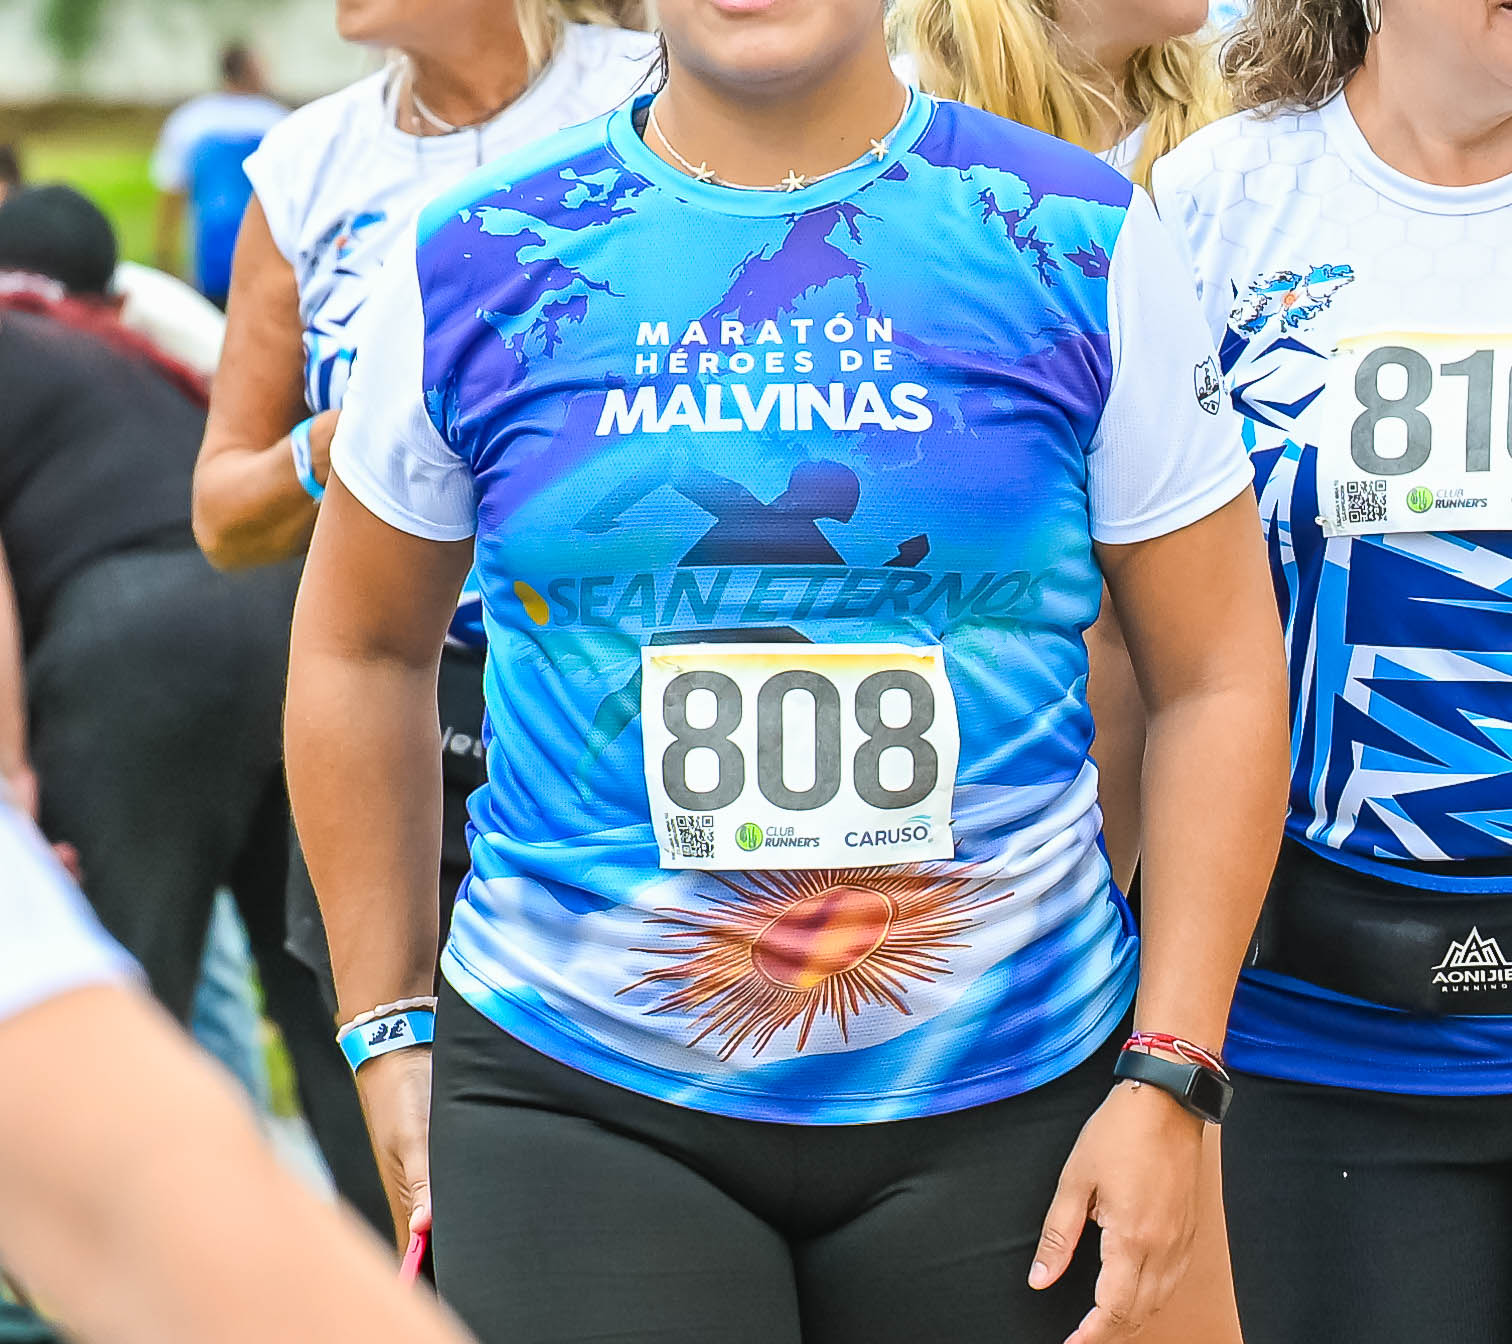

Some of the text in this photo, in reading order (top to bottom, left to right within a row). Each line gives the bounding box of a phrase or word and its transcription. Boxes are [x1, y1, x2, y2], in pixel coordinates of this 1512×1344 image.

[636, 312, 893, 346] MARATÓN
[635, 348, 893, 375] HÉROES DE
[595, 381, 934, 436] MALVINAS
[1434, 498, 1488, 509] RUNNER'S
[1435, 488, 1464, 498] CLUB
[547, 570, 1050, 628] SEAN ETERNOS
[661, 668, 938, 811] 808
[764, 836, 821, 848] RUNNER'S
[765, 826, 795, 837] CLUB
[844, 825, 929, 849] CARUSO
[1441, 983, 1508, 993] RUNNING
